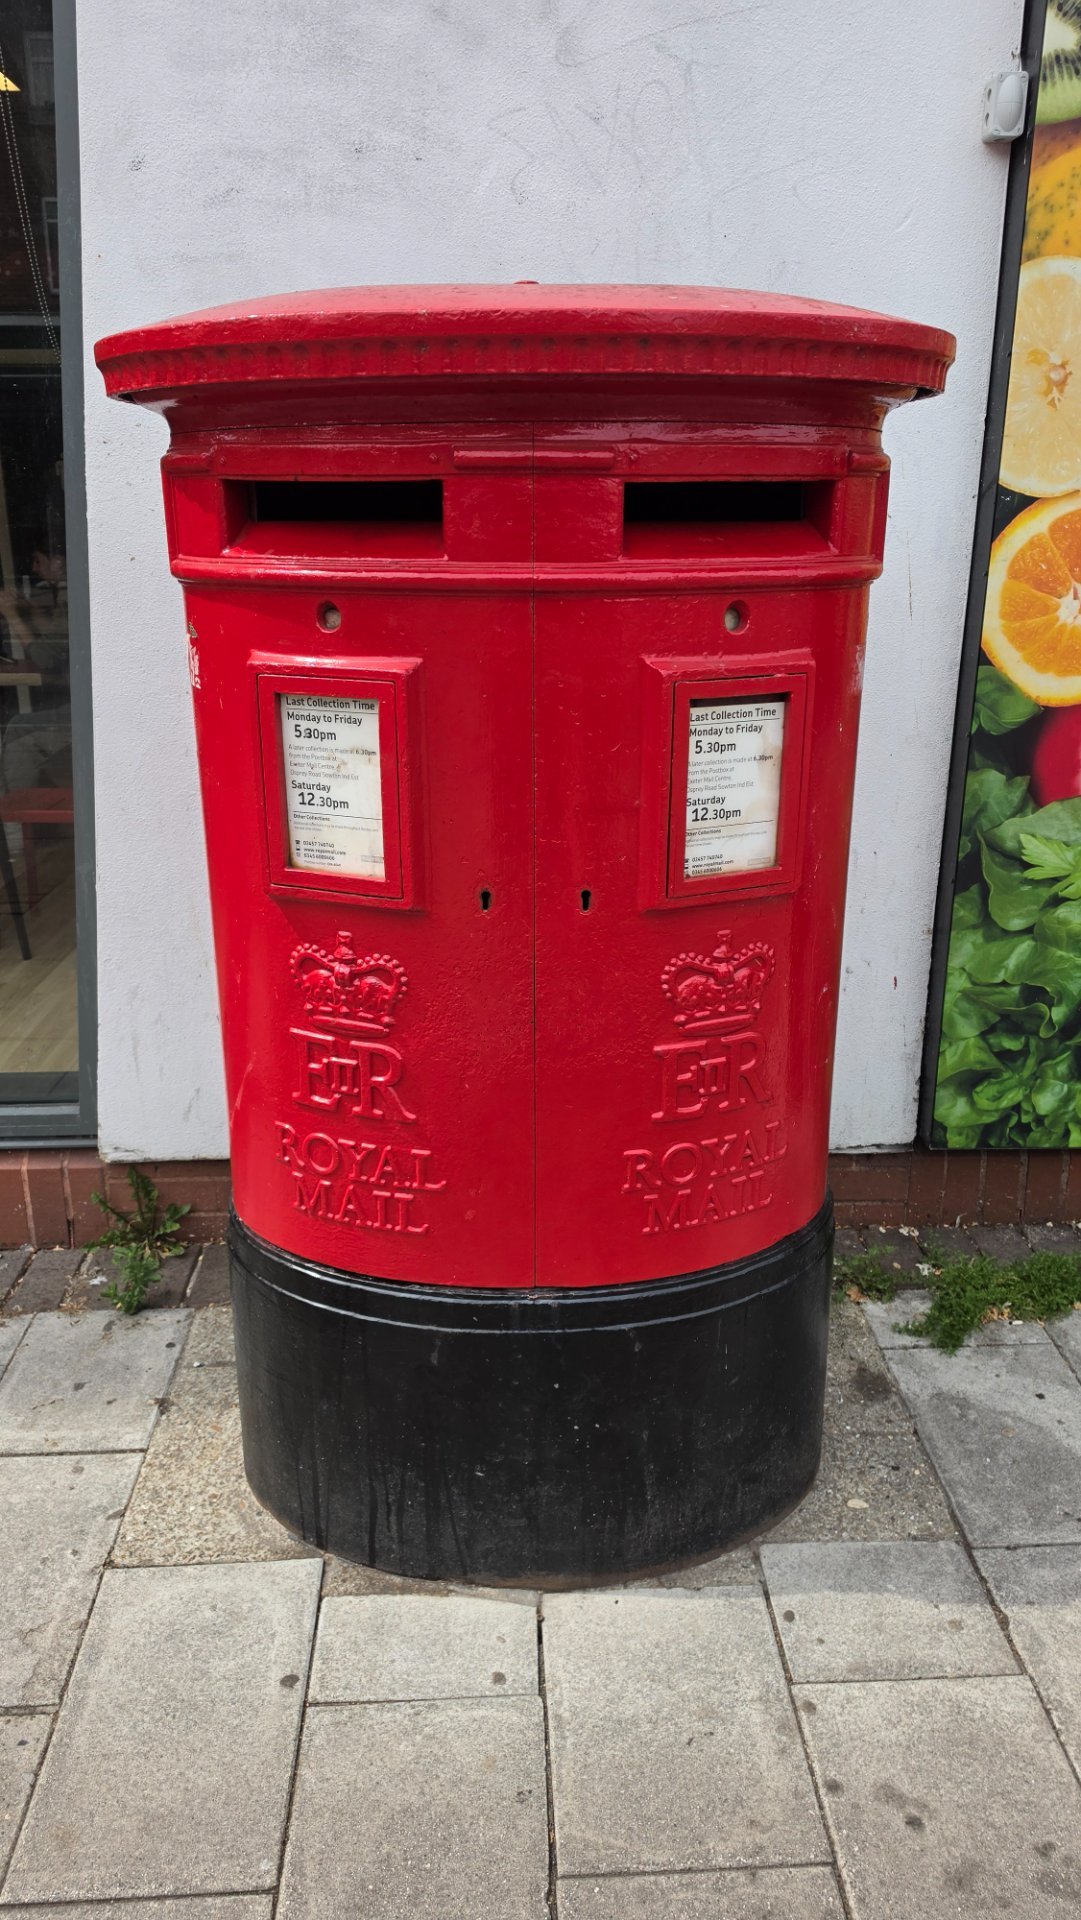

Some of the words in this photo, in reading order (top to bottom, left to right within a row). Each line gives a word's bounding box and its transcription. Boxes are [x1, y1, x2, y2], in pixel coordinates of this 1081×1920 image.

[286, 696, 305, 706] Last
[307, 696, 350, 709] Collection
[352, 700, 375, 710] Time
[287, 711, 321, 724] Monday
[323, 714, 332, 722] to
[335, 714, 362, 726] Friday
[690, 712, 709, 722] Last
[711, 709, 753, 720] Collection
[755, 708, 776, 716] Time
[690, 726, 723, 736] Monday
[736, 724, 763, 734] Friday
[695, 740, 736, 754] 5.30pm
[292, 780, 331, 793] Saturday
[298, 792, 349, 810] 12.30pm
[686, 796, 726, 806] Saturday
[692, 807, 741, 822] 12.30pm
[692, 860, 734, 869] www.royalmail.com
[274, 1122, 446, 1191] ROYAL
[622, 1120, 787, 1193] ROYAL
[292, 1172, 430, 1234] MAIL
[642, 1170, 773, 1234] MAIL
